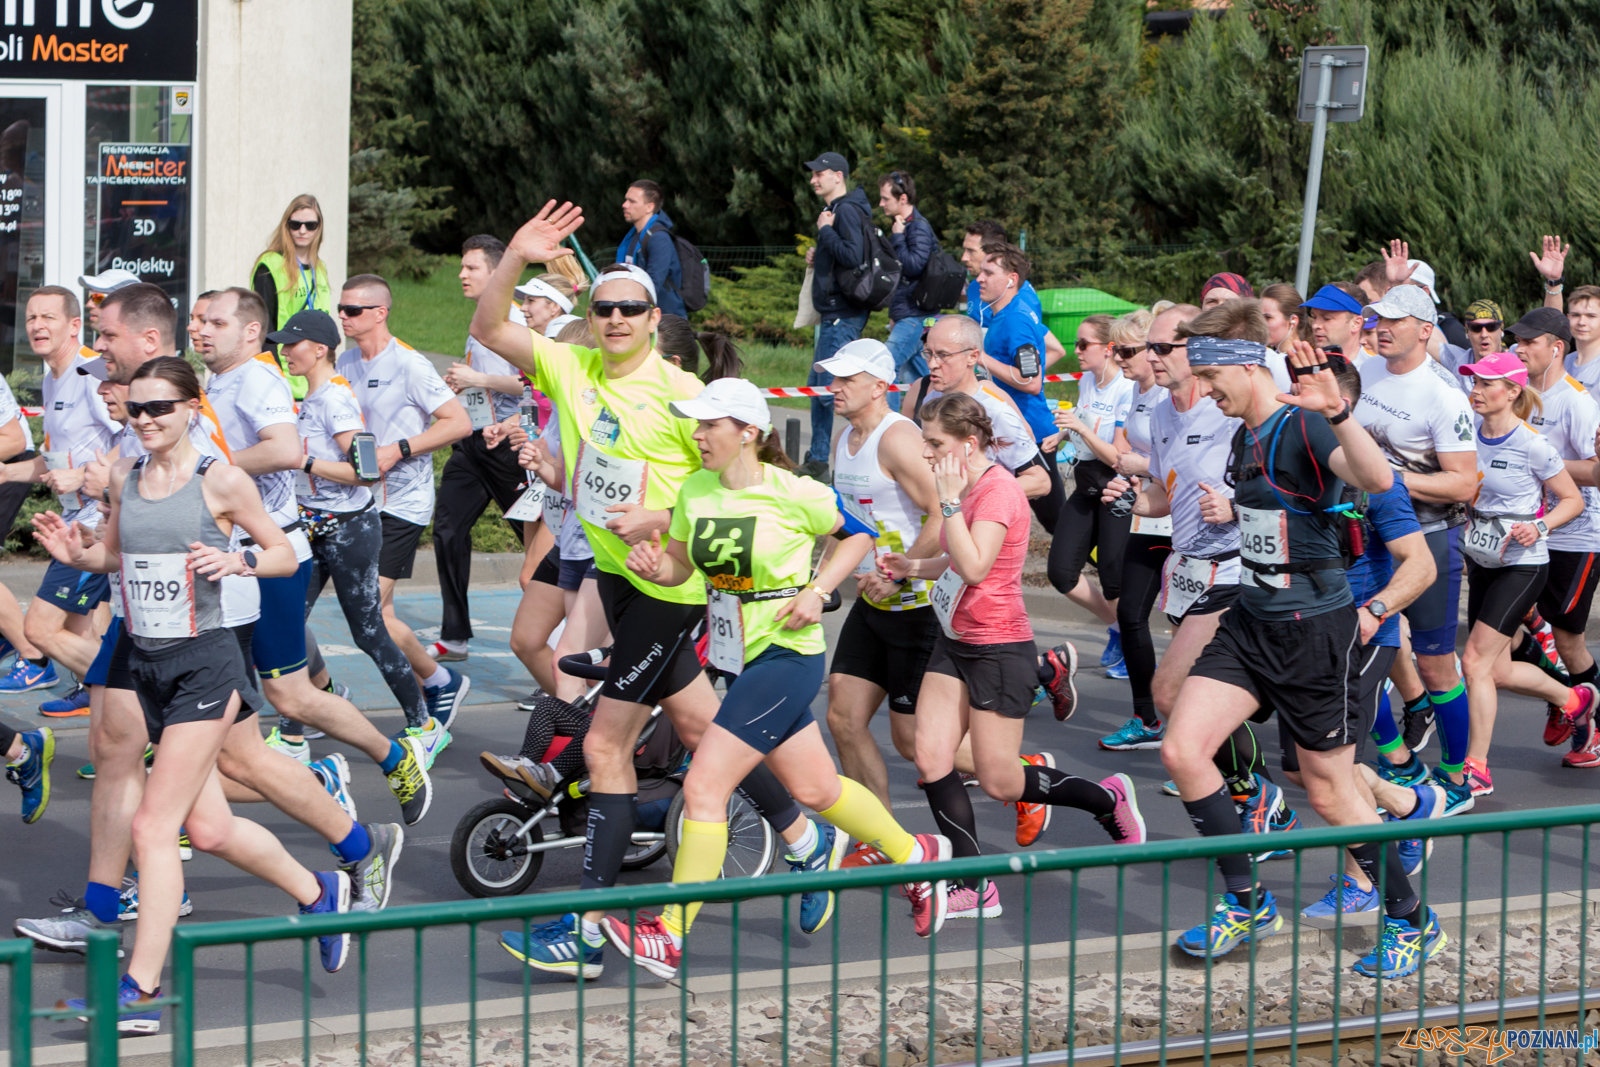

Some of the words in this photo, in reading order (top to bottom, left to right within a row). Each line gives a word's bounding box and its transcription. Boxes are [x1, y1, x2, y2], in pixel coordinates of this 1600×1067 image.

[32, 34, 129, 63] Master
[102, 146, 170, 154] RENOWACJA
[86, 176, 186, 185] TAPICEROWANYCH
[133, 219, 156, 236] 3D
[112, 256, 174, 277] Projekty
[584, 471, 631, 502] 4969
[1470, 530, 1501, 551] 10511
[128, 580, 181, 601] 11789
[1172, 572, 1205, 594] 5889
[614, 642, 664, 691] Kalenji
